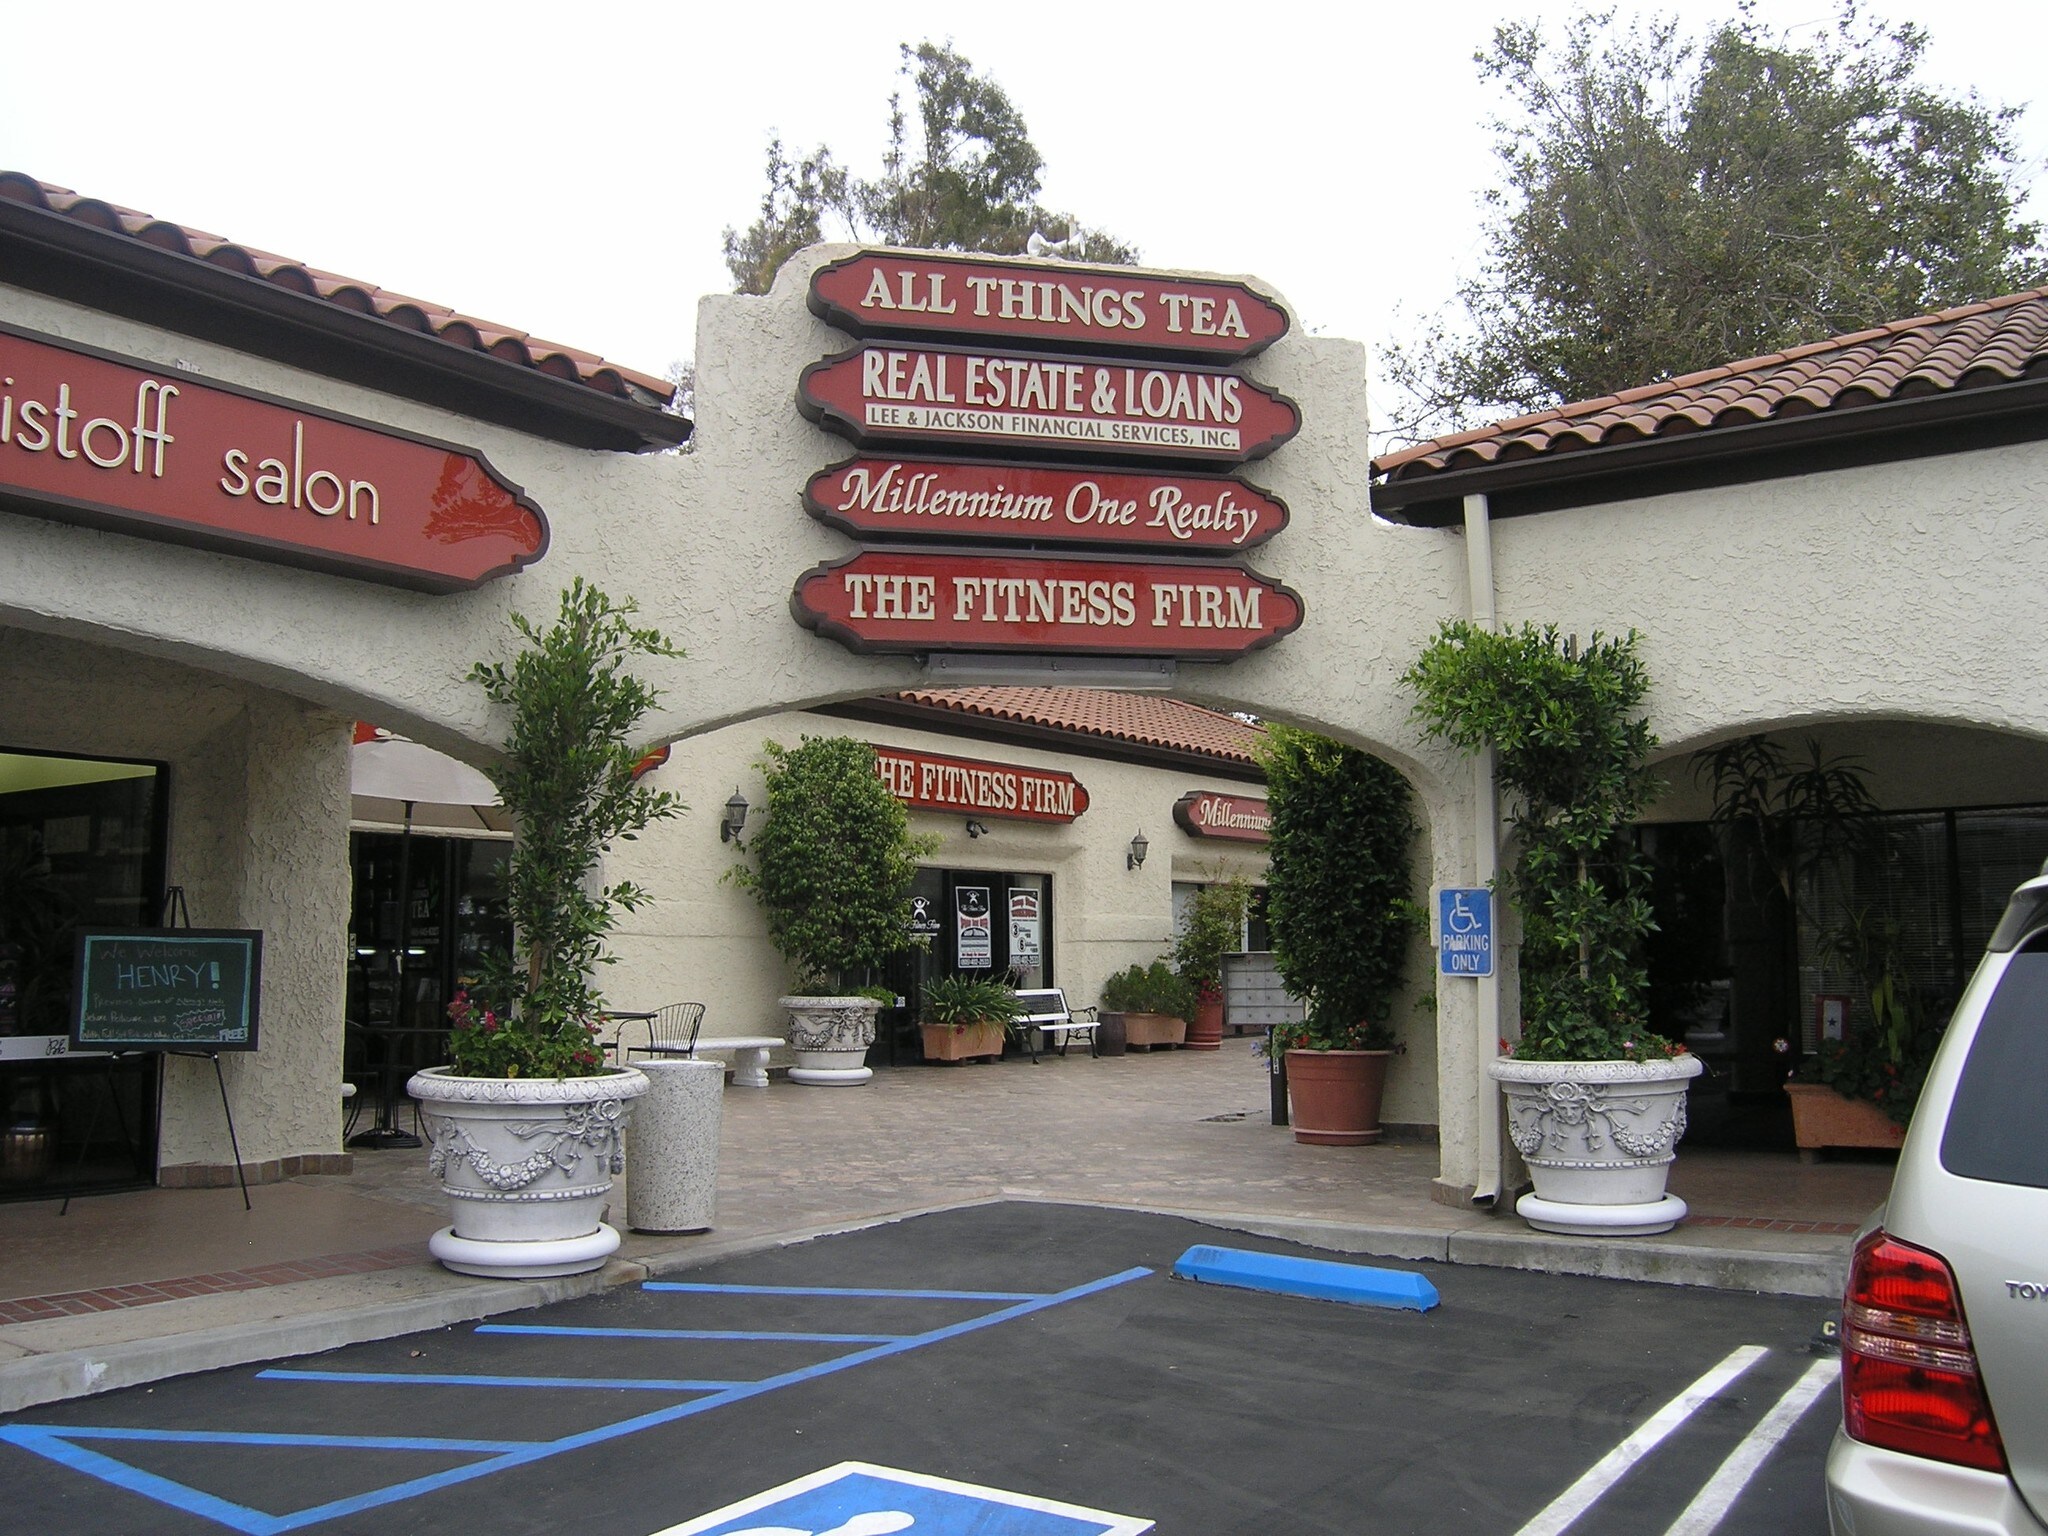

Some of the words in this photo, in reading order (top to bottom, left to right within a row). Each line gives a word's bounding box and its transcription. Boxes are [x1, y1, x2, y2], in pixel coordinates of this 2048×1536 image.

[861, 267, 956, 315] ALL
[967, 276, 1146, 330] THINGS
[1160, 292, 1250, 339] TEA
[863, 350, 955, 403] REAL
[966, 357, 1084, 412] ESTATE
[1091, 368, 1117, 415] &
[1125, 369, 1242, 424] LOANS
[0, 377, 180, 478] istoff
[220, 419, 380, 525] salon
[871, 408, 899, 424] LEE
[907, 411, 918, 426] &
[925, 411, 1004, 431] JACKSON
[1012, 417, 1105, 438] FINANCIAL
[1112, 423, 1194, 445] SERVICES,
[1201, 430, 1237, 447] INC.
[837, 464, 1054, 522] Millennium
[1064, 480, 1138, 526] One
[1146, 486, 1259, 544] Realty
[845, 573, 936, 621] THE
[952, 576, 1136, 628] FITNESS
[1150, 583, 1264, 630] FIRM
[874, 756, 914, 798] HE
[920, 762, 1017, 810] FITNESS
[1021, 776, 1076, 815] FIRM
[411, 899, 430, 918] TEA
[1443, 934, 1489, 952] PARKING
[1452, 954, 1480, 971] ONLY
[117, 961, 220, 990] HENRY!
